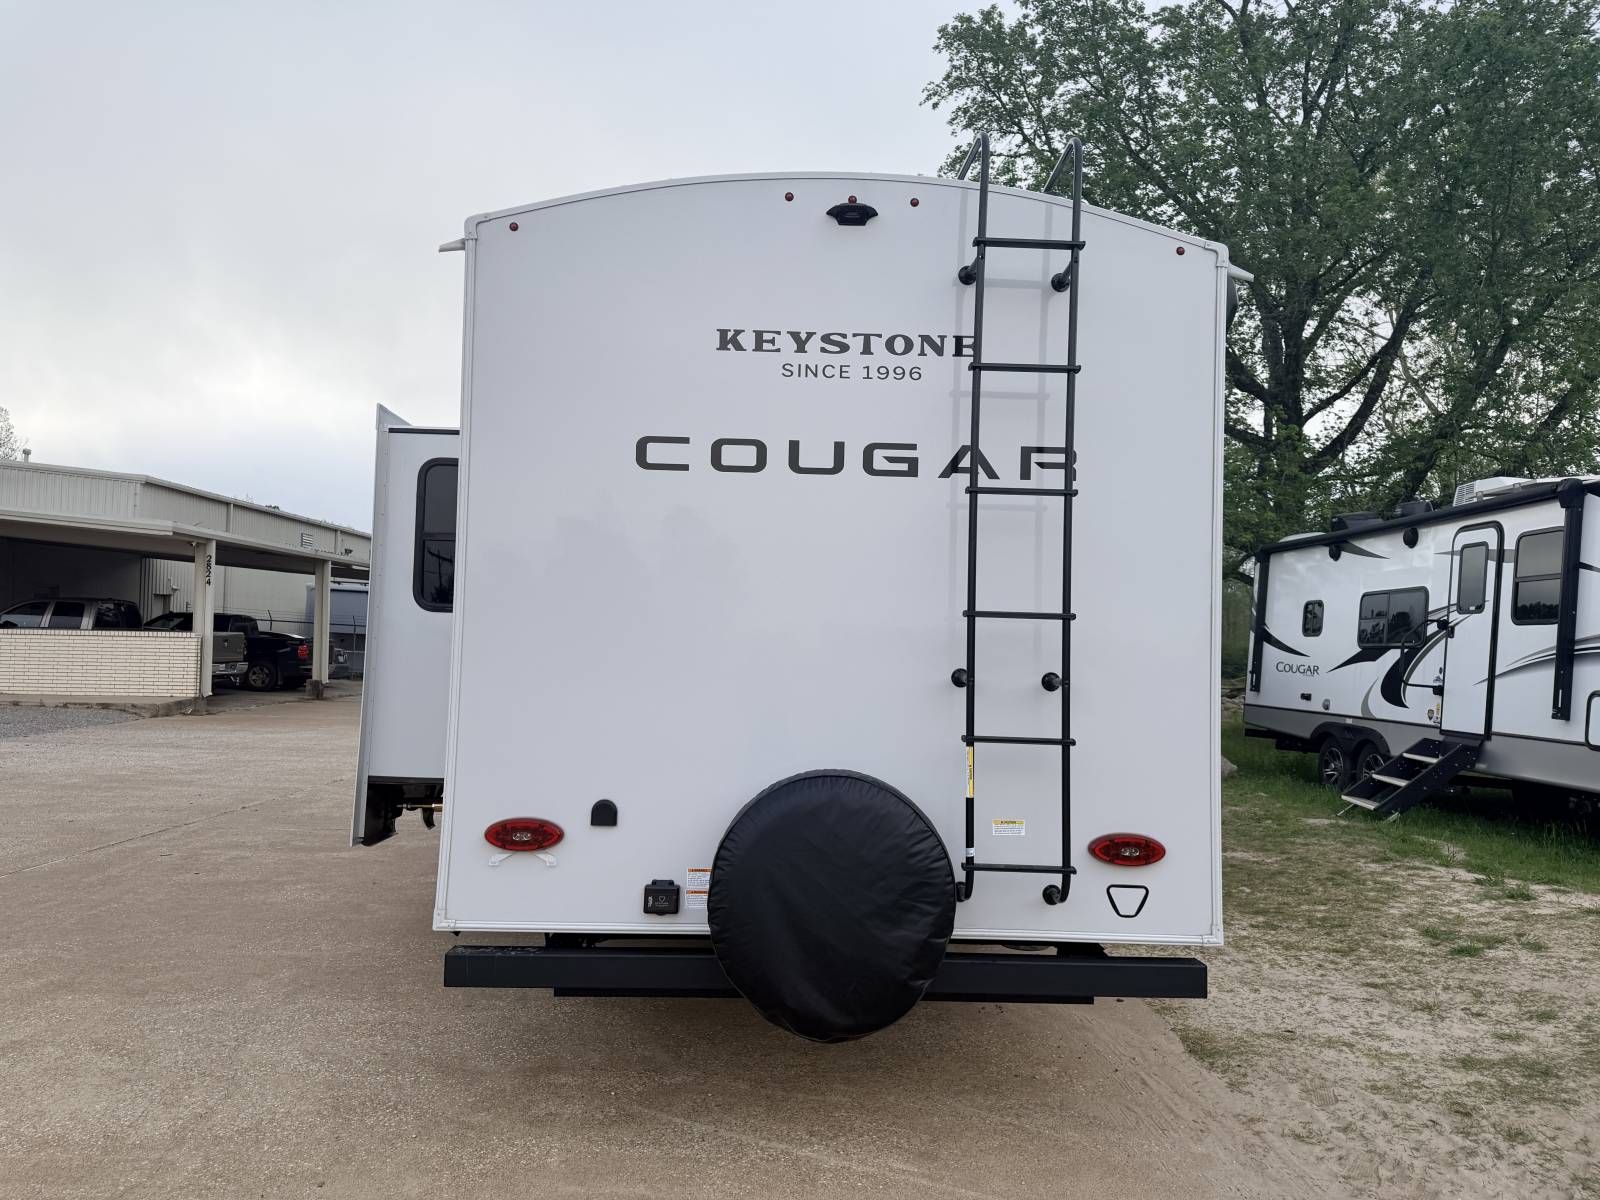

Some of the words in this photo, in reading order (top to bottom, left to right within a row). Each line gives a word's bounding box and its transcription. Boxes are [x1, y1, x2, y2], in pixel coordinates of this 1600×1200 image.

[716, 328, 975, 358] KEYSTONE
[781, 363, 850, 379] SINCE
[862, 365, 922, 381] 1996
[635, 435, 1077, 482] COUGAR
[1275, 660, 1320, 676] COUGAR
